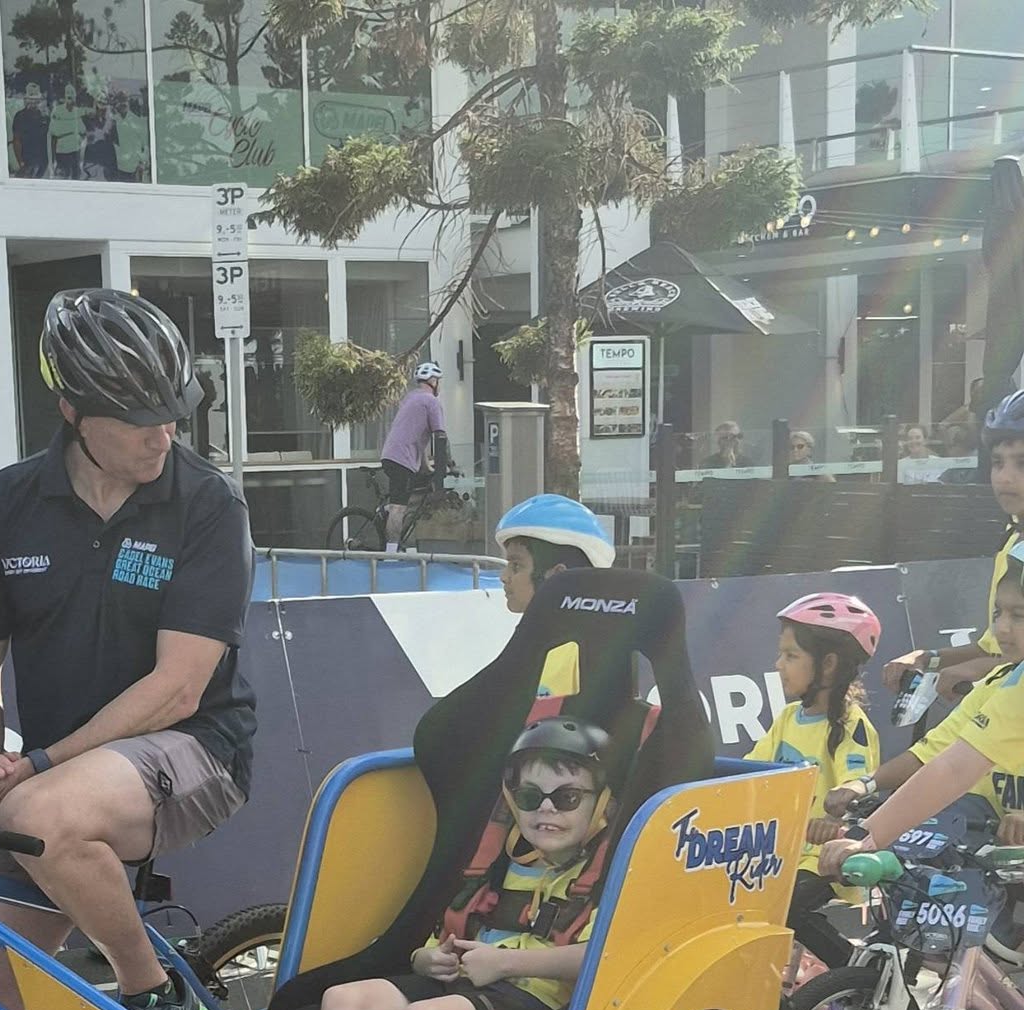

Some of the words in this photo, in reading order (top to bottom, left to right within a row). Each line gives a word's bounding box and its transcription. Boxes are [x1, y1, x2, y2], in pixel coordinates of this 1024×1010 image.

[229, 138, 274, 168] Club
[216, 188, 244, 206] 3P
[216, 266, 243, 285] 3P
[600, 348, 636, 359] TEMPO
[489, 423, 499, 444] P
[115, 559, 141, 574] GREAT
[142, 564, 172, 581] OCEAN
[118, 549, 144, 562] CADEL
[145, 553, 175, 570] EVANS
[112, 569, 135, 585] ROAD
[136, 575, 160, 590] RACE
[560, 596, 638, 615] MONZA
[686, 820, 777, 869] DREAM
[726, 850, 782, 904] Rider
[916, 902, 967, 928] 5086
